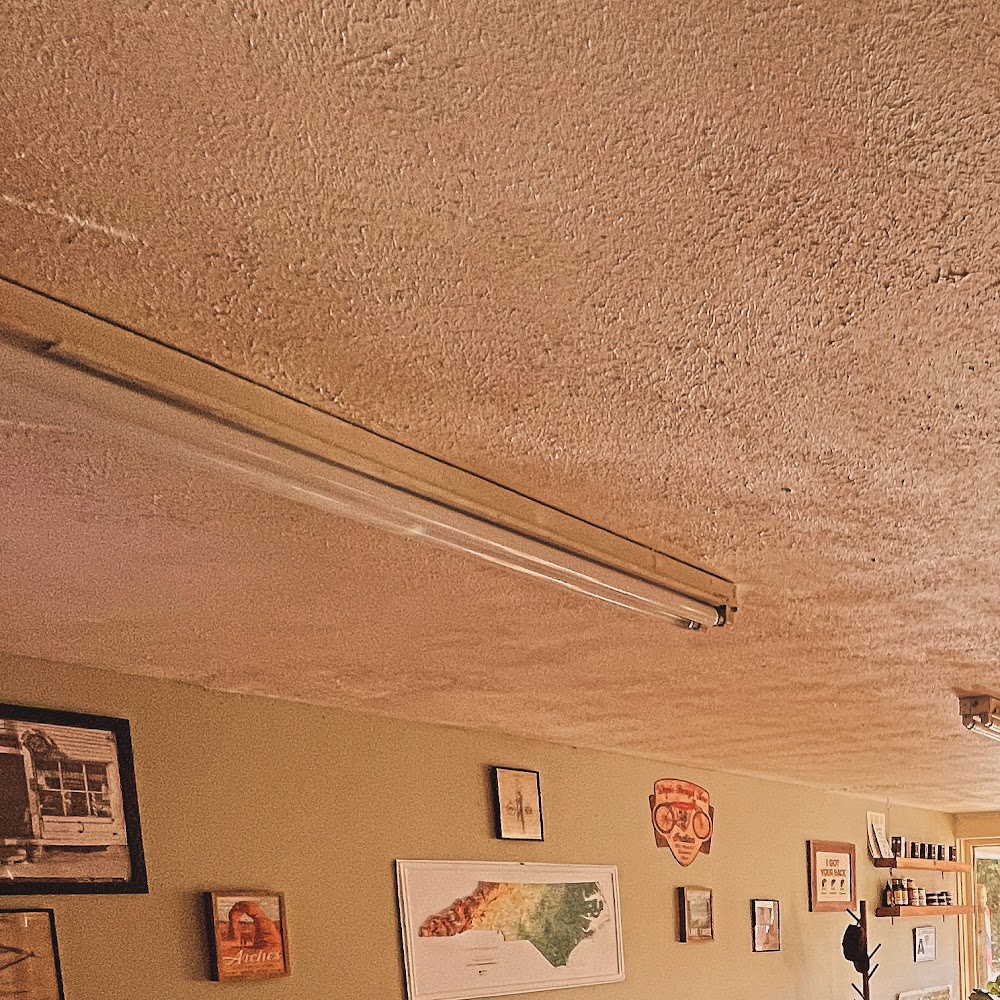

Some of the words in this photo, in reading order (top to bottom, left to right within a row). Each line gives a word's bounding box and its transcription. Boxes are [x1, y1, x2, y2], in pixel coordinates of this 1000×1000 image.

[829, 859, 839, 868] GOT
[820, 869, 833, 877] YOUR
[917, 939, 925, 955] A
[223, 949, 281, 966] Arches
